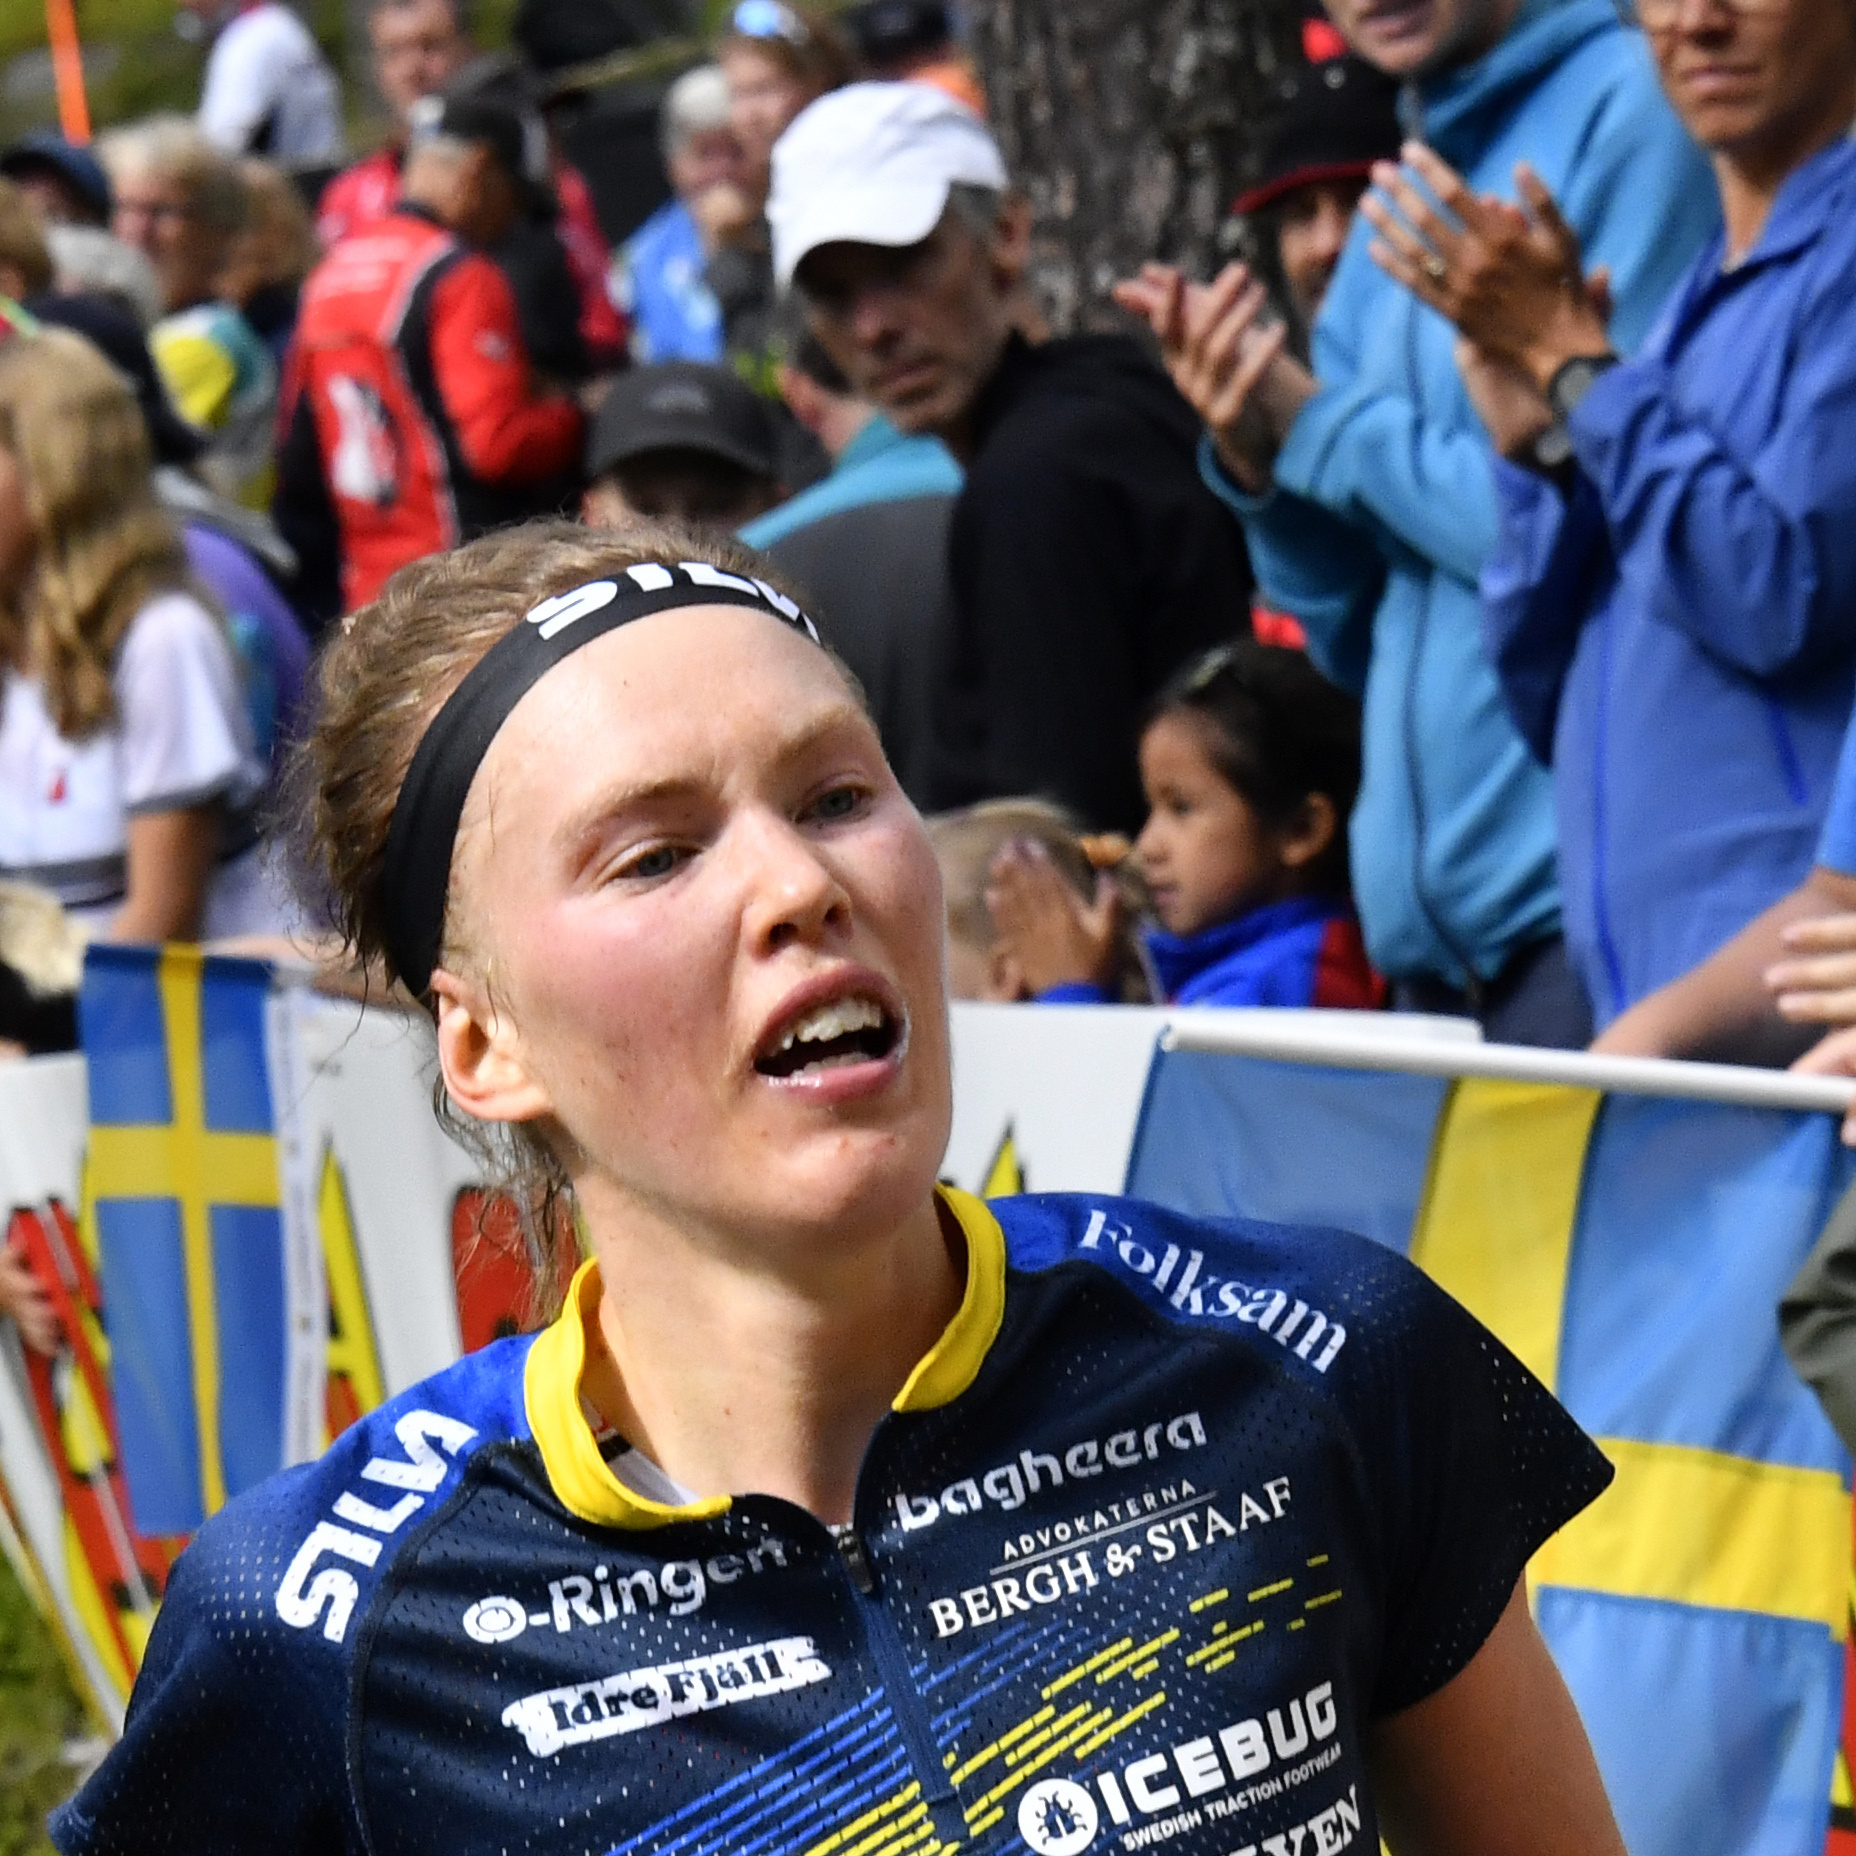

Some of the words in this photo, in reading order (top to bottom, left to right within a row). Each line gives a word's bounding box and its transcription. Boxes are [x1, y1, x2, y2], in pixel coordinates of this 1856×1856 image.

[1079, 1208, 1346, 1375] Folksam
[893, 1411, 1208, 1533] bagheera
[1001, 1478, 1197, 1561] ADVOKATERNA
[928, 1551, 1100, 1639] BERGH
[1105, 1541, 1143, 1579] &
[1145, 1475, 1293, 1564] STAAF
[551, 1678, 660, 1732] Idre
[663, 1648, 786, 1708] Fjäll
[1096, 1679, 1338, 1826] ICEBUG
[1123, 1810, 1204, 1852] SWEDISH
[1204, 1780, 1284, 1823] TRACTION
[1282, 1740, 1343, 1791] FOOTWEAR
